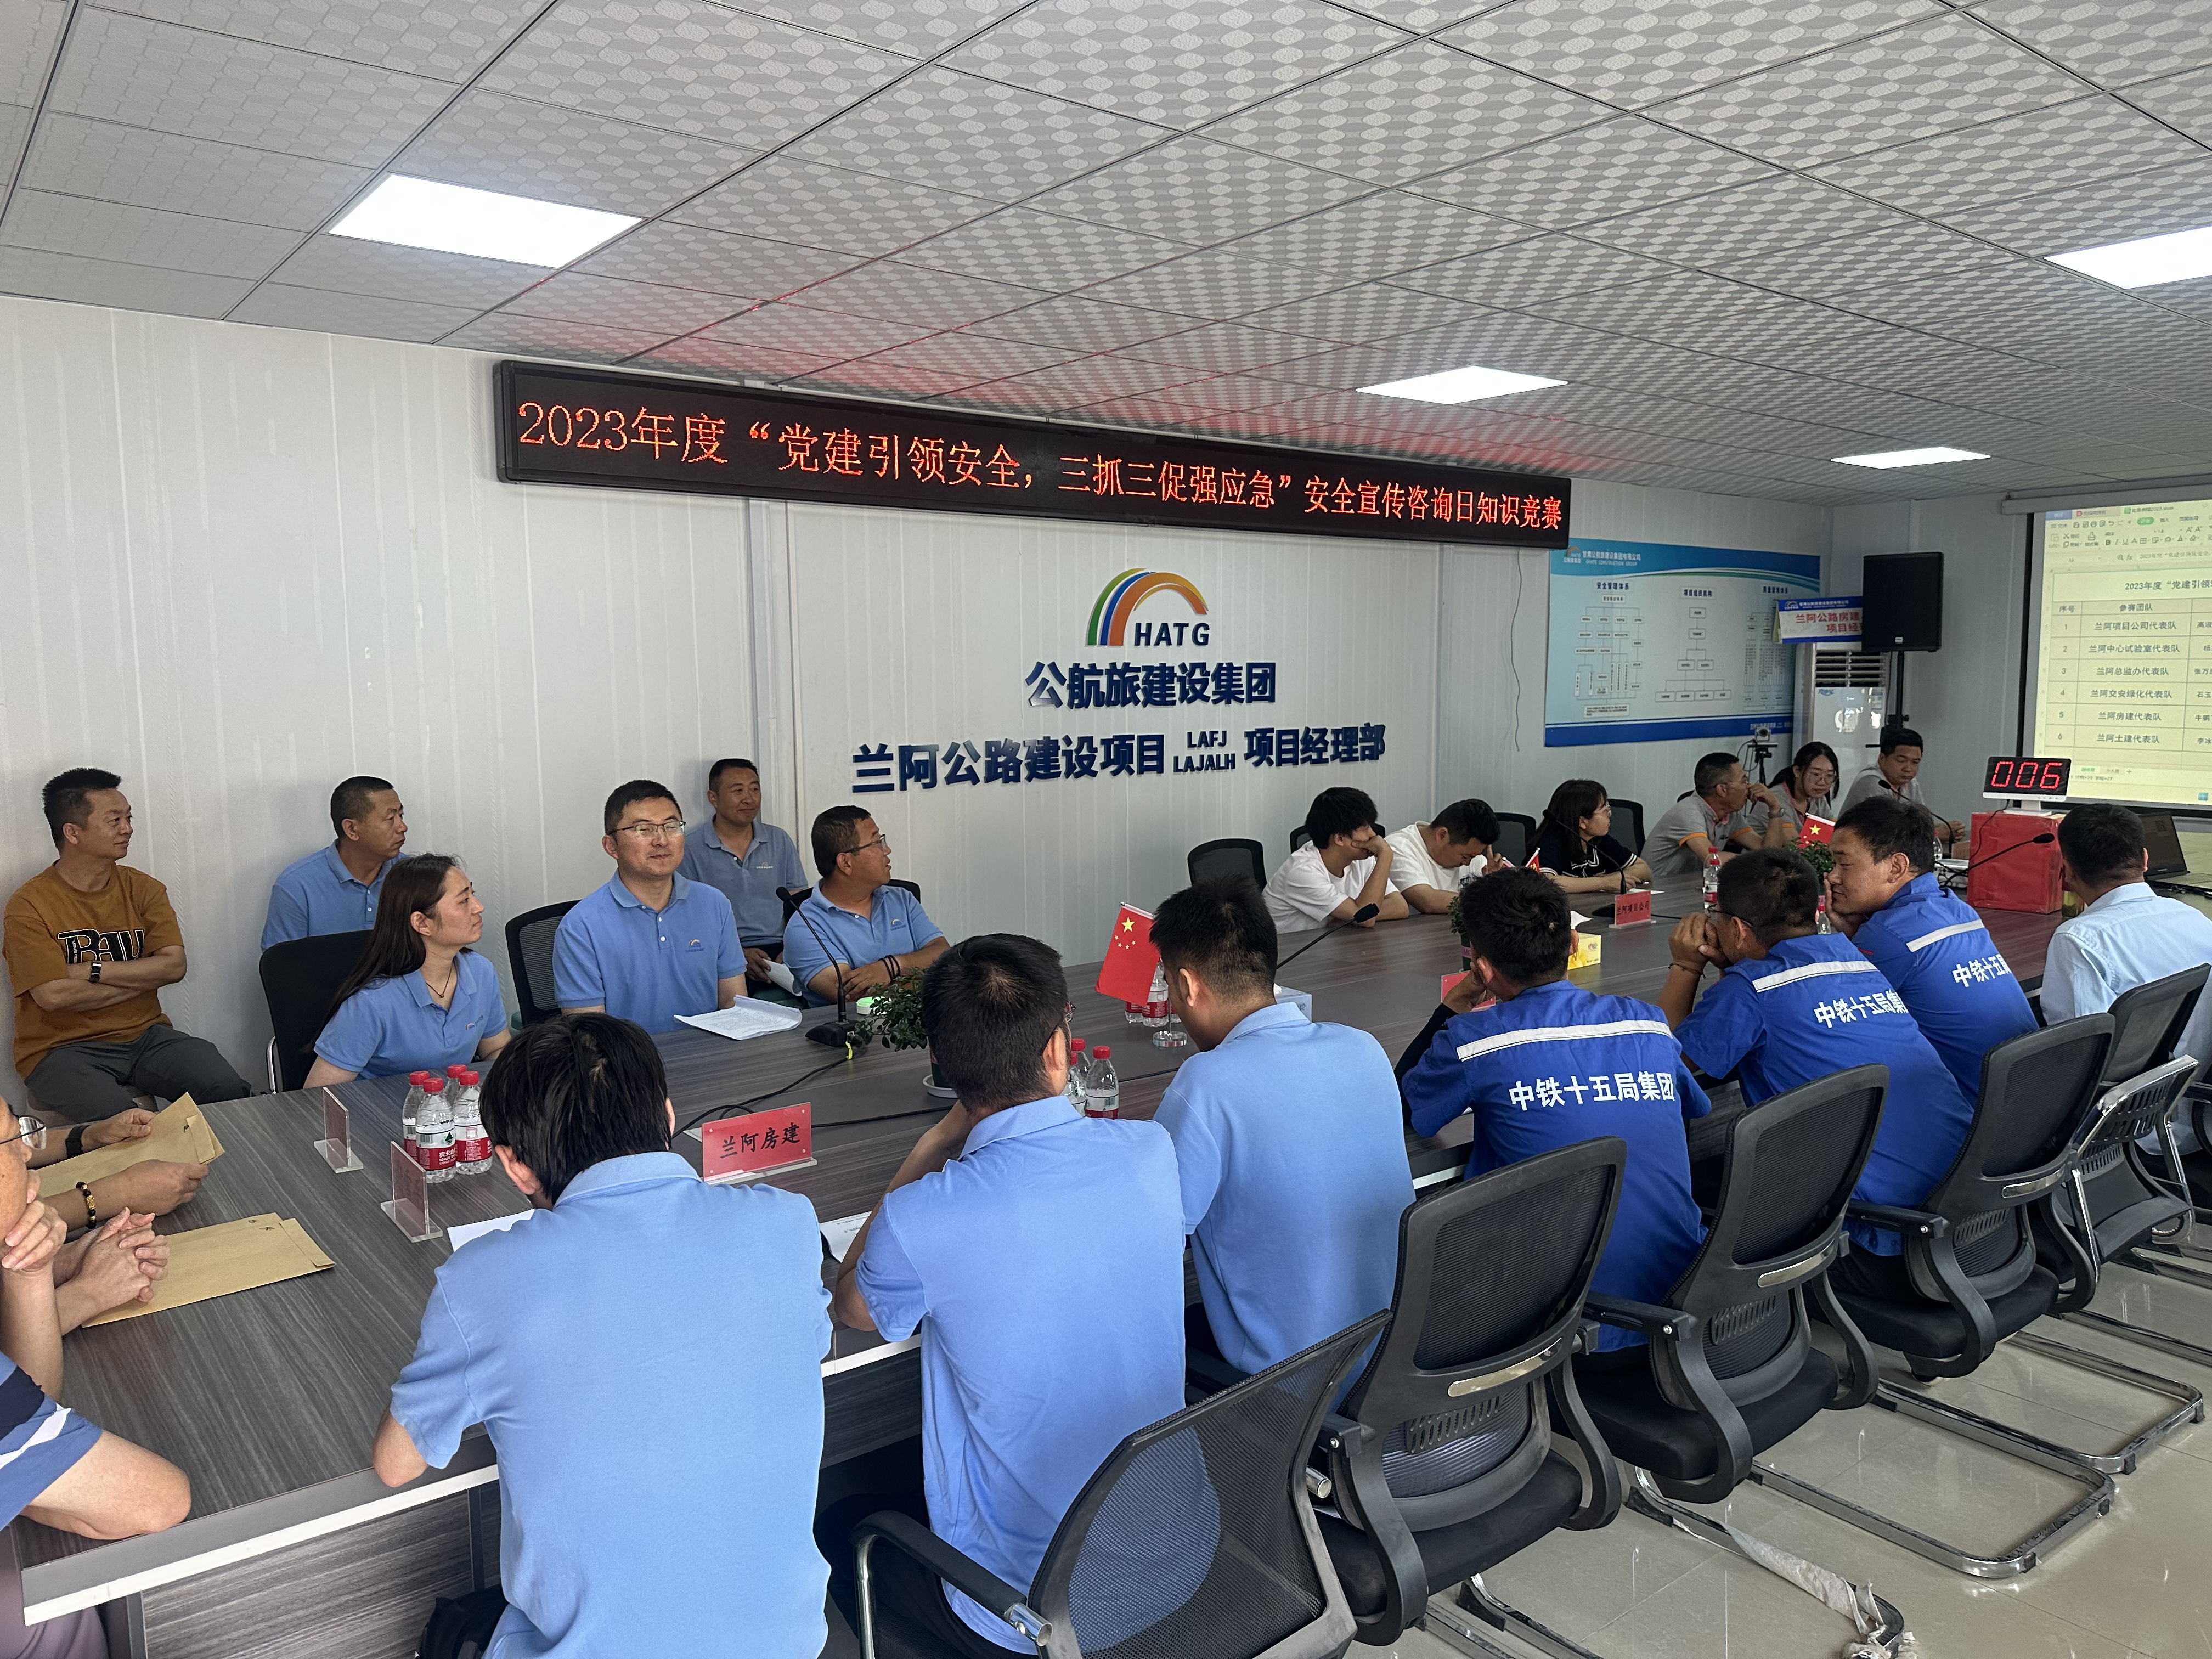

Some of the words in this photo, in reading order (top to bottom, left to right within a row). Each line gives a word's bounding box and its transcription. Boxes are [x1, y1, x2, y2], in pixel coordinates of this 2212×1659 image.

[1596, 582, 1629, 590] 安全管理体系
[2059, 605, 2075, 613] 序号
[2119, 603, 2153, 612] 参赛团队
[1795, 611, 1860, 623] 兰阿公路房建
[1826, 623, 1863, 633] 项目经
[2094, 620, 2177, 631] 兰阿项目公司代表队
[1134, 623, 1210, 647] HATG
[2089, 644, 2180, 653] 兰阿中心试验室代表队
[2096, 667, 2169, 676] 兰阿总监办代表队
[1025, 661, 1276, 710] 公航旅建设集团
[2090, 689, 2172, 699] 兰阿交安绿化代表队
[2097, 711, 2162, 721] 兰阿房建代表队
[1187, 730, 1228, 749] LAFJ
[2097, 733, 2160, 744] 兰阿土建代表队
[1243, 722, 1386, 768] 项目经理部
[852, 734, 1164, 793] 兰阿公路建设项目
[1173, 753, 1236, 773] LAJALH
[1991, 761, 2063, 789] 006
[1814, 990, 1909, 1028] 中铁十五局集
[1509, 1070, 1675, 1111] 中铁十五局集团
[719, 1122, 800, 1159] 兰阿房建
